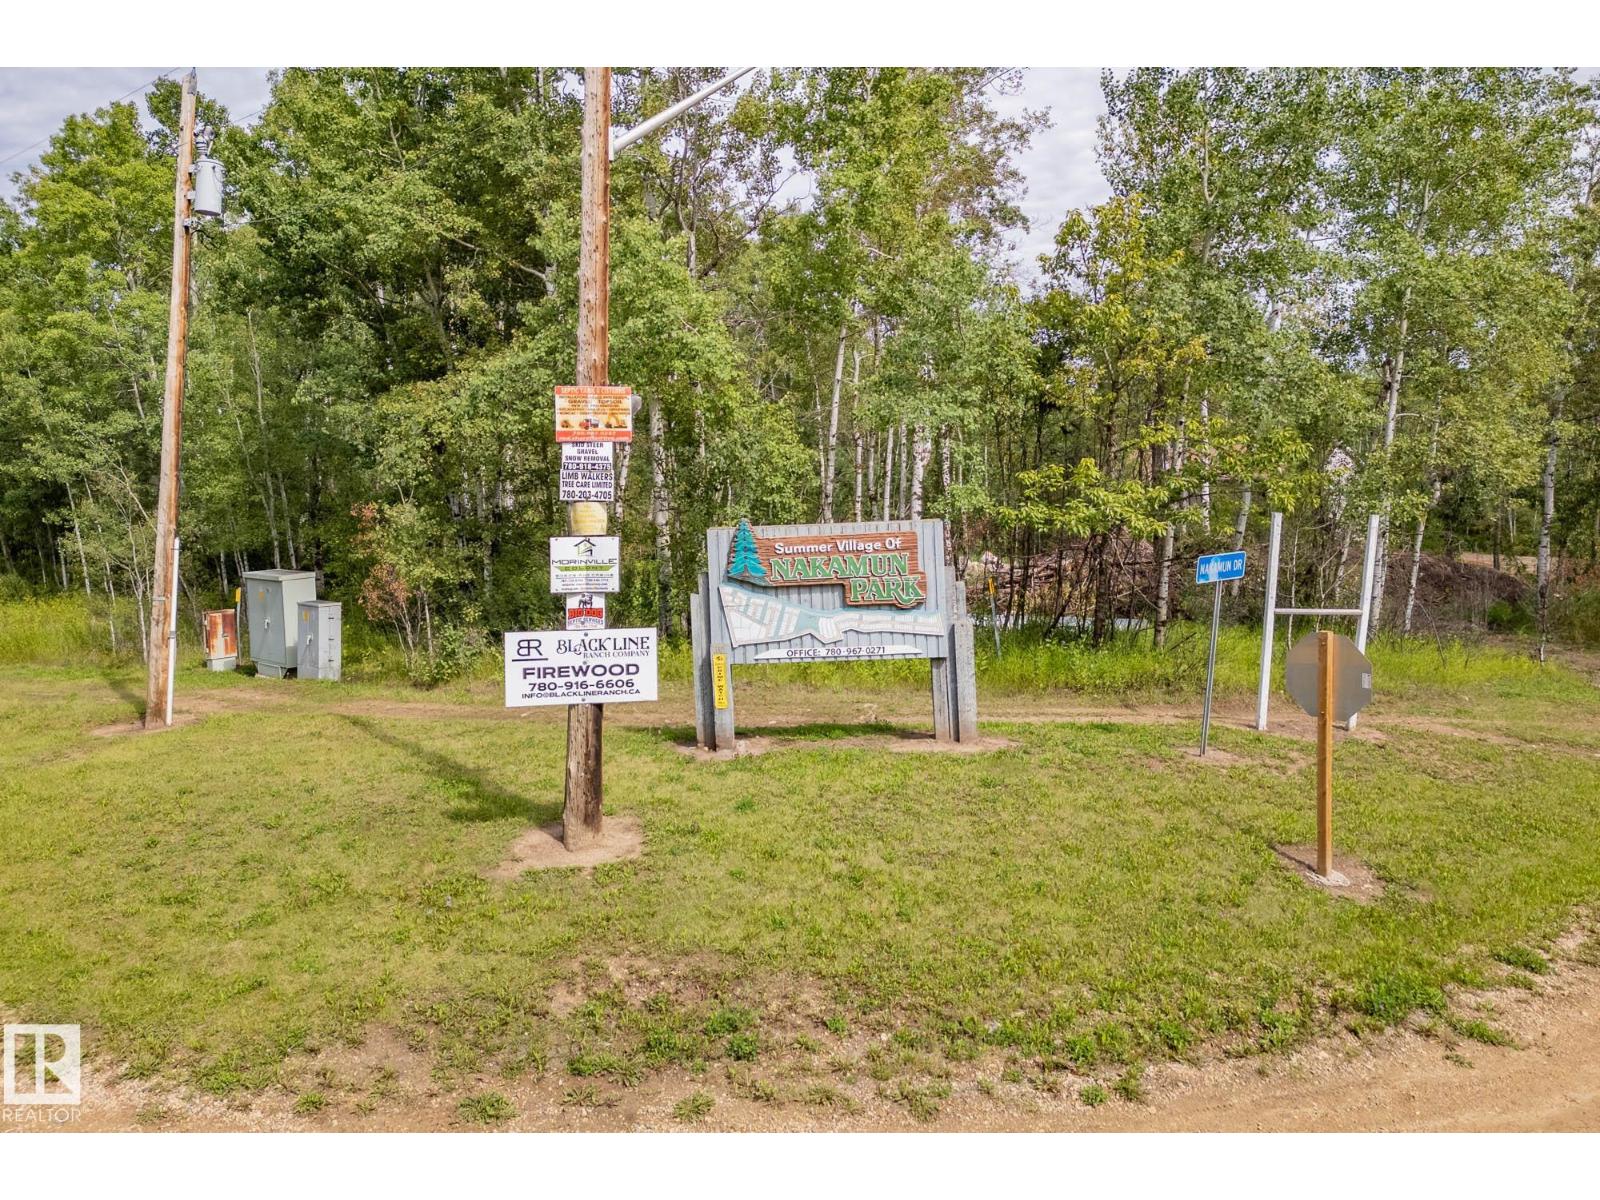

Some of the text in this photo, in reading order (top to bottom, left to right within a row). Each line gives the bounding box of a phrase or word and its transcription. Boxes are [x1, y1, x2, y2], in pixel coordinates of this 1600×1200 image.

[562, 472, 613, 481] LIMB WALKERS
[562, 490, 612, 500] 780-203-4705
[774, 537, 902, 555] Summer Village Of
[770, 553, 910, 581] NAKAMUN
[1233, 559, 1243, 571] DR
[850, 576, 926, 605] PARK
[556, 636, 650, 656] BLACK LINE
[583, 650, 650, 659] RANCH COMPANY
[786, 649, 821, 657] OFFICE:
[522, 663, 640, 680] FIREWOOD
[528, 679, 635, 691] 780-916-6606
[521, 688, 641, 699] INFO@BLACKLINERANCH.CA
